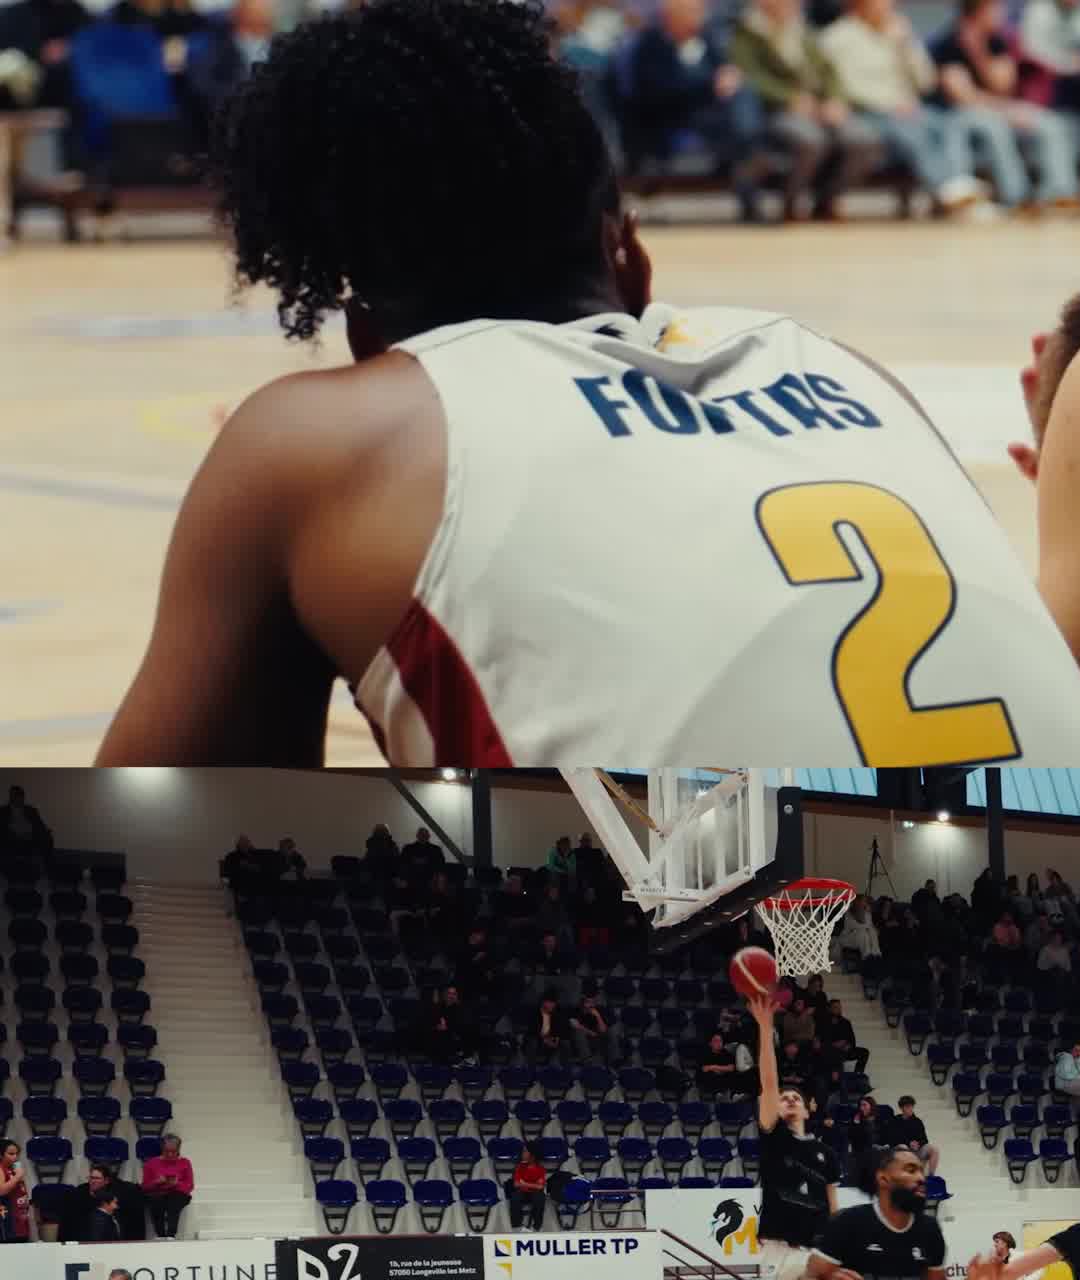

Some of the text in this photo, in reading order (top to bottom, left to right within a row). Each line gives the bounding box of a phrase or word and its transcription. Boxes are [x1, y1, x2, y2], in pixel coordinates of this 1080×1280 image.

[755, 480, 1022, 767] 2
[516, 1238, 639, 1257] MULLER TP
